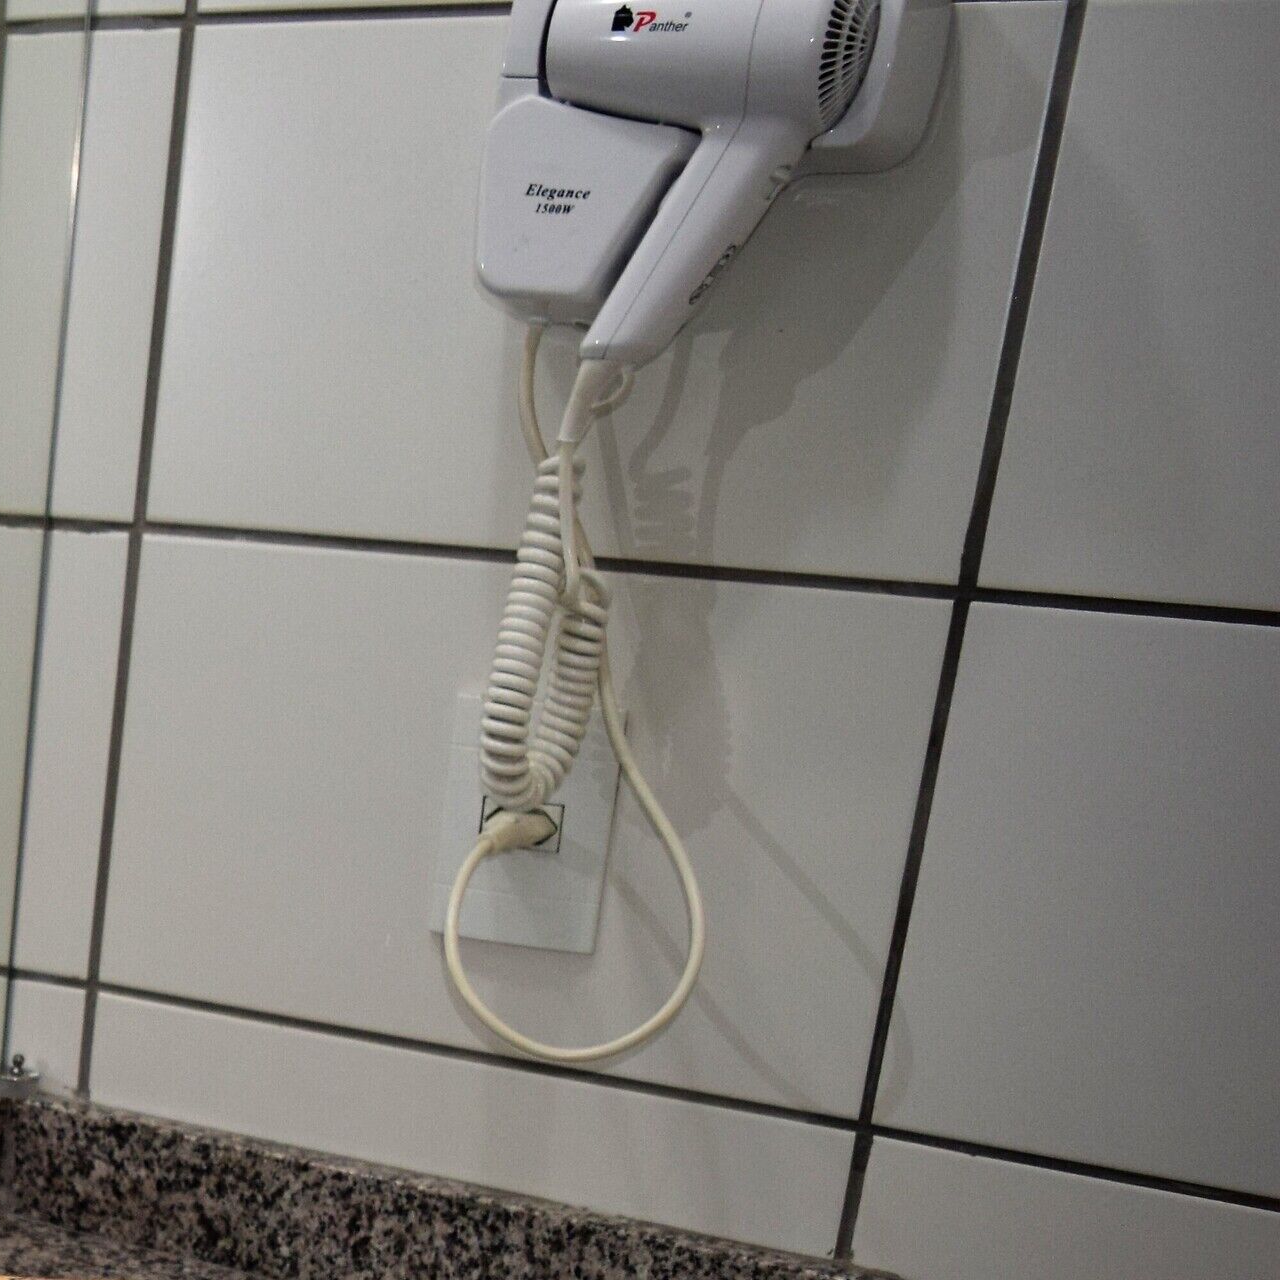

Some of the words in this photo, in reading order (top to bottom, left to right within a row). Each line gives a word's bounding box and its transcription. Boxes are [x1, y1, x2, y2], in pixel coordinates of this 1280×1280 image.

[633, 11, 690, 33] Panther
[525, 183, 591, 201] Elegance
[536, 203, 575, 215] 1500W
